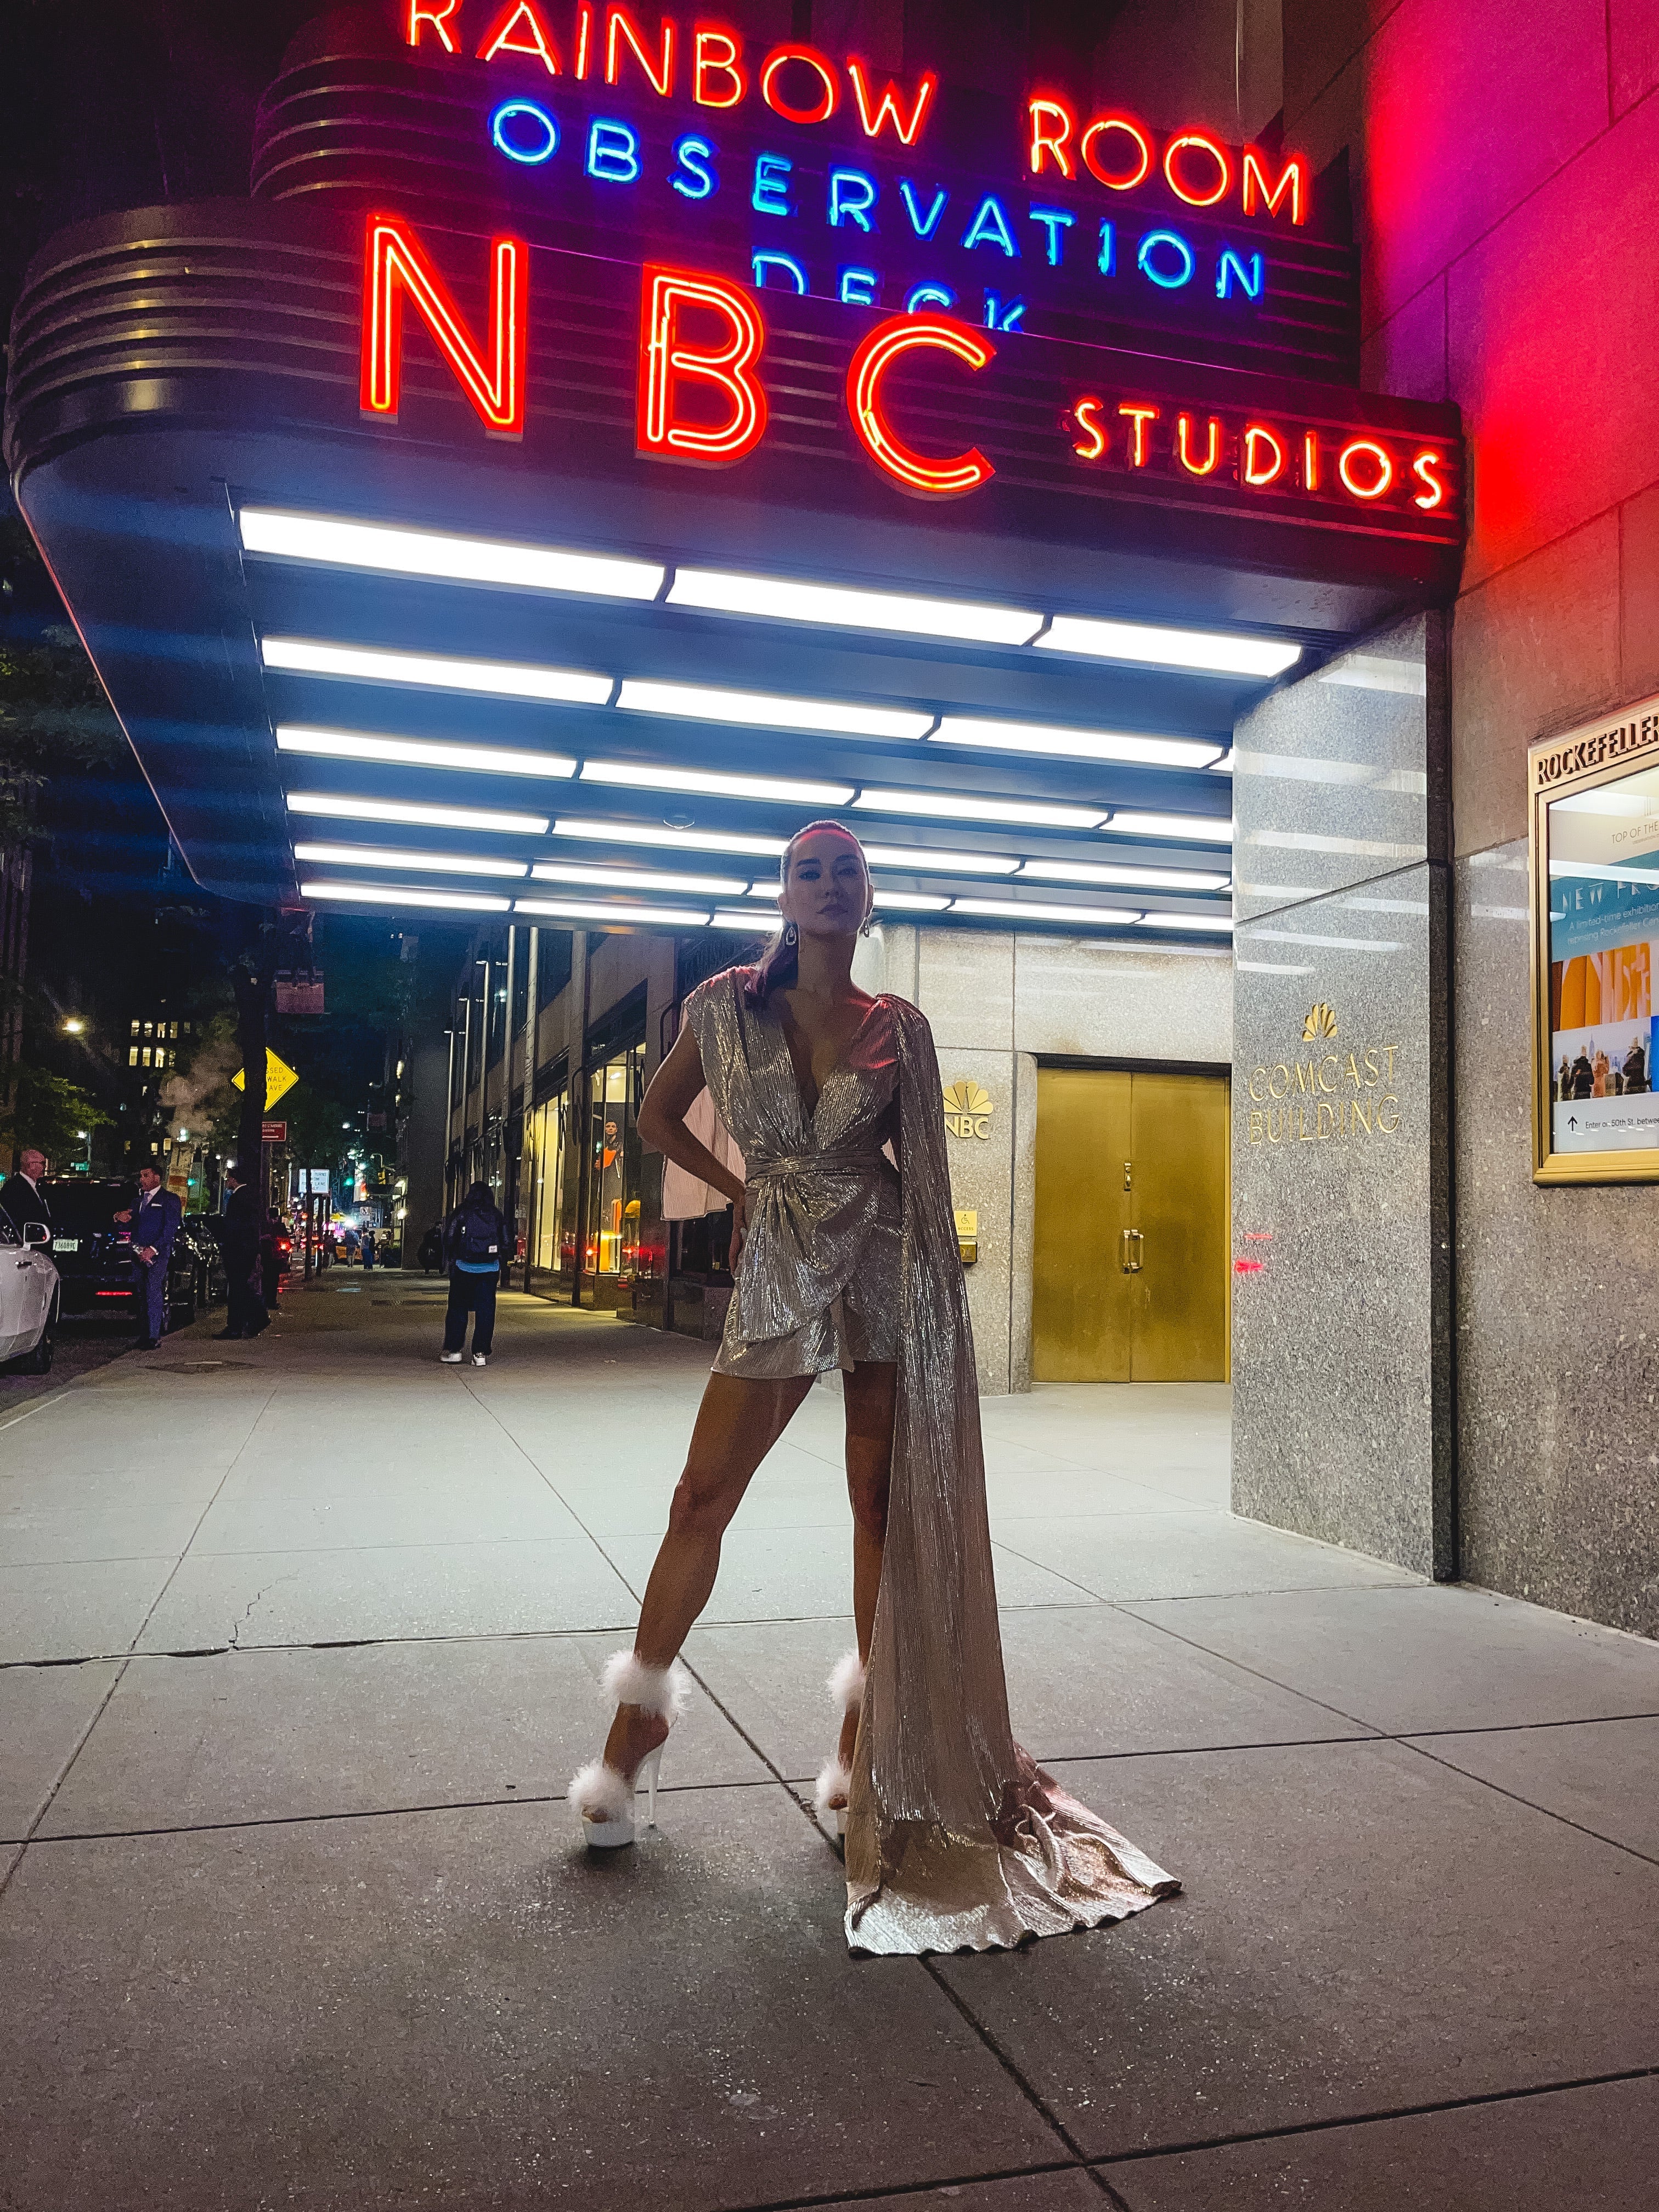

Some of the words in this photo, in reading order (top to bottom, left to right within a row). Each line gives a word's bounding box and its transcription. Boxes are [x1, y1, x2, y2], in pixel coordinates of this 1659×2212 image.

[406, 0, 936, 146] RAINBOW
[1029, 94, 1306, 225] ROOM
[491, 98, 1264, 303] OBSERVATION
[359, 213, 996, 494] NBC
[1073, 396, 1442, 509] STUDIOS
[1537, 713, 1659, 785] ROCKEFELLER
[1612, 831, 1628, 844] TOP
[1629, 826, 1641, 838] OF
[1644, 821, 1658, 834] THE
[1569, 922, 1575, 930] A
[1249, 1045, 1398, 1102] COMCAST
[944, 1116, 988, 1139] NBC
[1249, 1094, 1399, 1145] BUILDING
